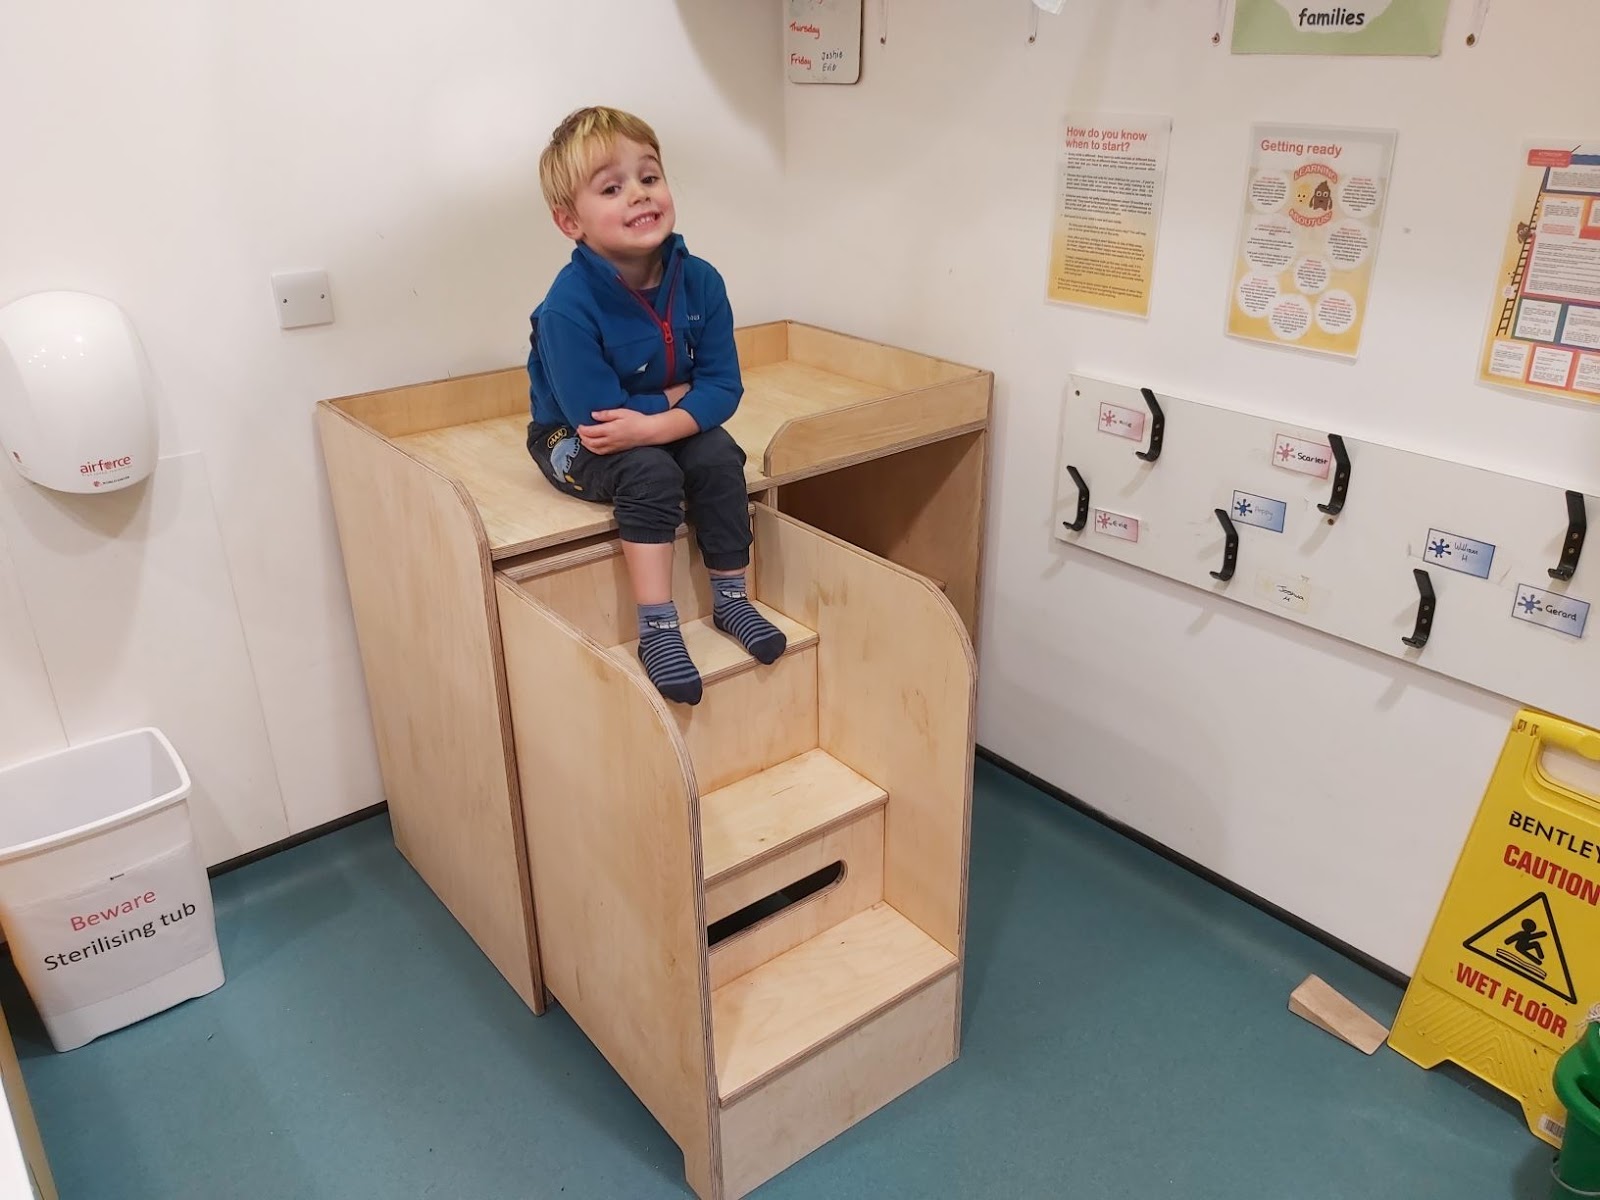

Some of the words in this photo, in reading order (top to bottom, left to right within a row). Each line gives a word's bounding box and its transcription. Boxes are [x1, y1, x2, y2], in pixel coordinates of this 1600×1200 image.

[1299, 8, 1365, 27] families
[790, 21, 820, 40] Thursday
[790, 53, 812, 71] Friday
[1066, 127, 1086, 137] How
[1087, 128, 1100, 139] do
[1101, 131, 1119, 141] you
[1120, 130, 1147, 141] know
[1065, 139, 1089, 149] when
[1091, 140, 1100, 150] to
[1102, 141, 1131, 152] start?
[1261, 139, 1304, 156] Getting
[1306, 145, 1342, 159] ready
[1293, 163, 1338, 184] LEARNING
[1461, 554, 1468, 562] H
[1545, 604, 1577, 622] Gerard
[1503, 844, 1600, 906] CAUTION
[70, 890, 157, 932] Beware
[44, 921, 156, 971] Sterilising
[160, 902, 196, 927] tub
[1456, 962, 1502, 1000] WET
[1501, 987, 1568, 1039] FLOOR
